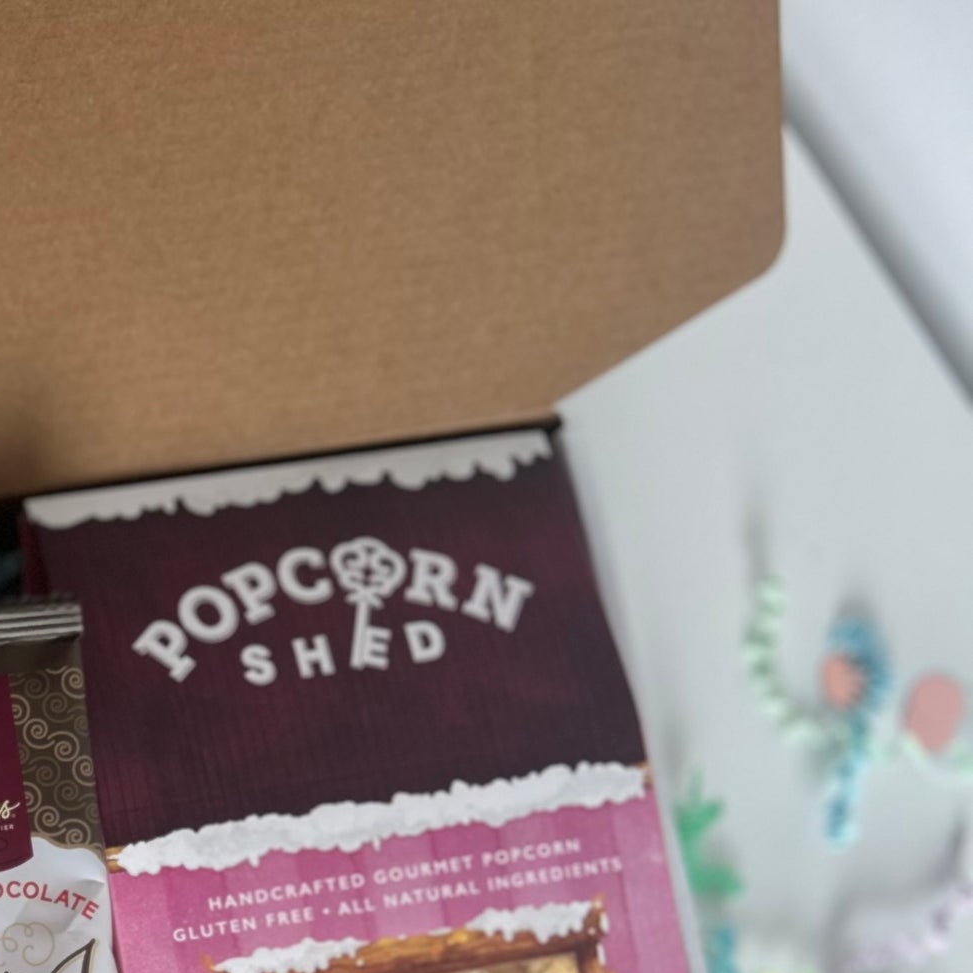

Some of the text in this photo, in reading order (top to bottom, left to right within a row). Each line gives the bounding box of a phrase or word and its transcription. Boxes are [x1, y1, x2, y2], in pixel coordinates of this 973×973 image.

[132, 537, 534, 682] POPCORN
[241, 620, 447, 686] SHED
[172, 856, 624, 943] GLUTEN FREE ALL NATURAL INGREDIENTS
[208, 838, 582, 912] HANDCRAFTED GOURMET POPCORN
